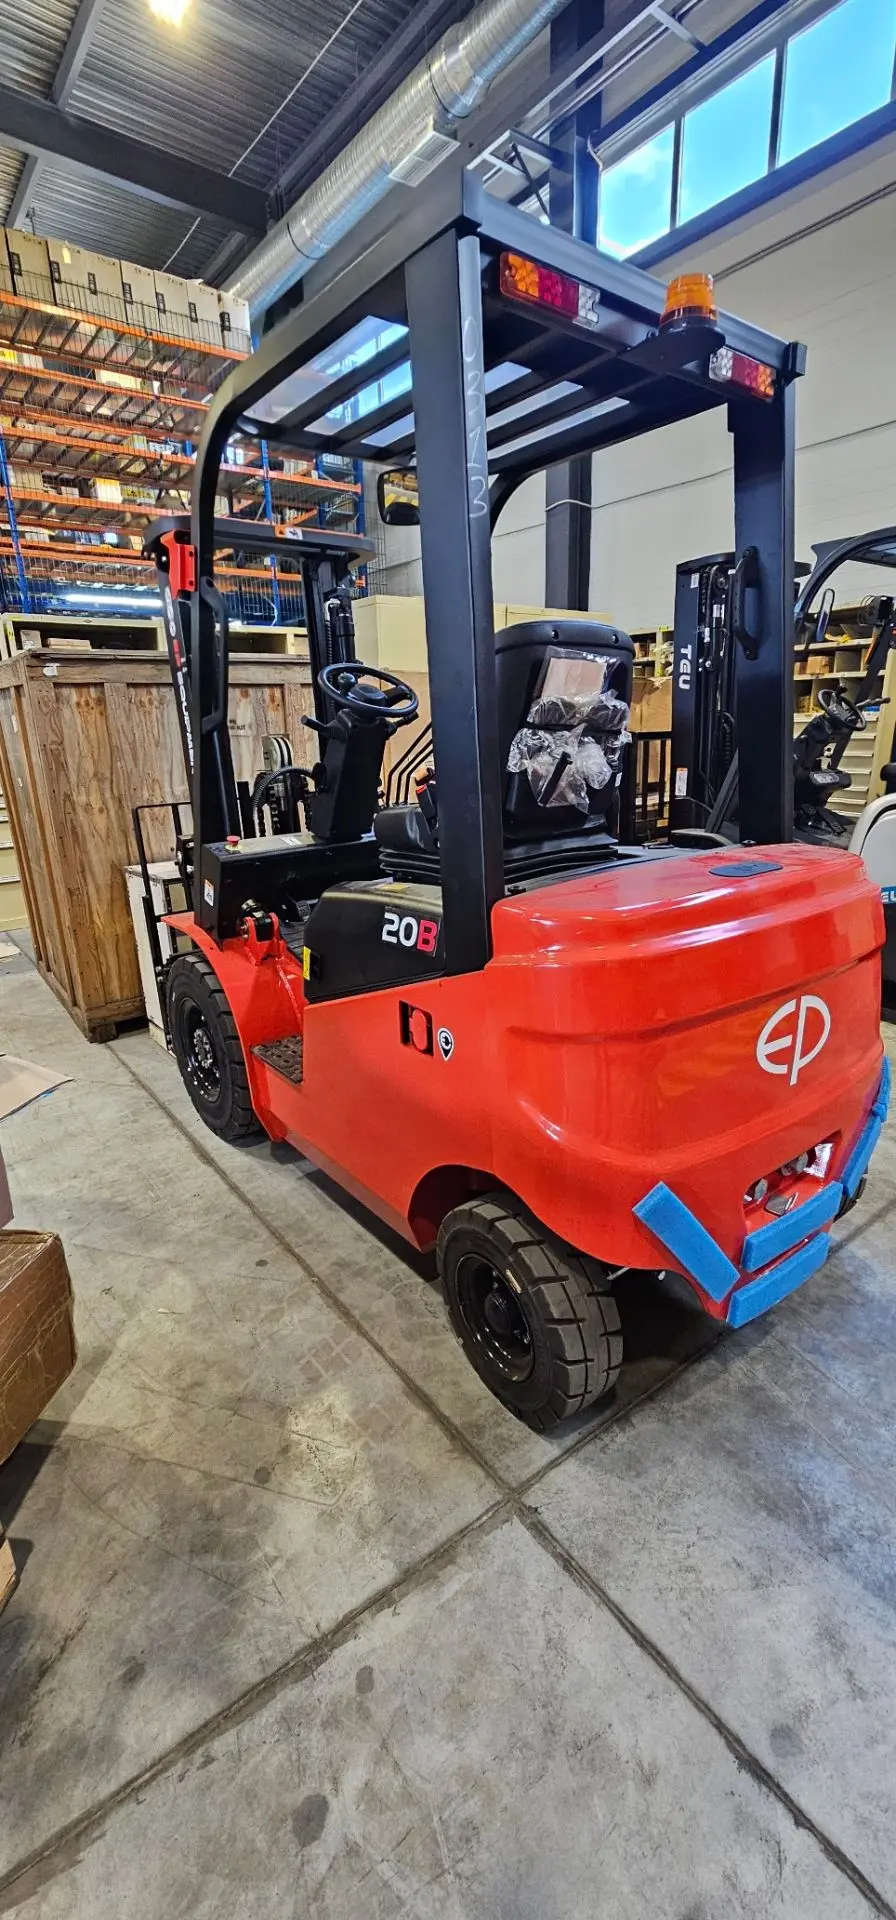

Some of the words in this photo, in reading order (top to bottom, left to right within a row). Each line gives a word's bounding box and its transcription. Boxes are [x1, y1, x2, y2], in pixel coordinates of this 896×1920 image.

[679, 644, 692, 690] TEU
[382, 912, 438, 952] 20B
[756, 995, 830, 1086] EP
